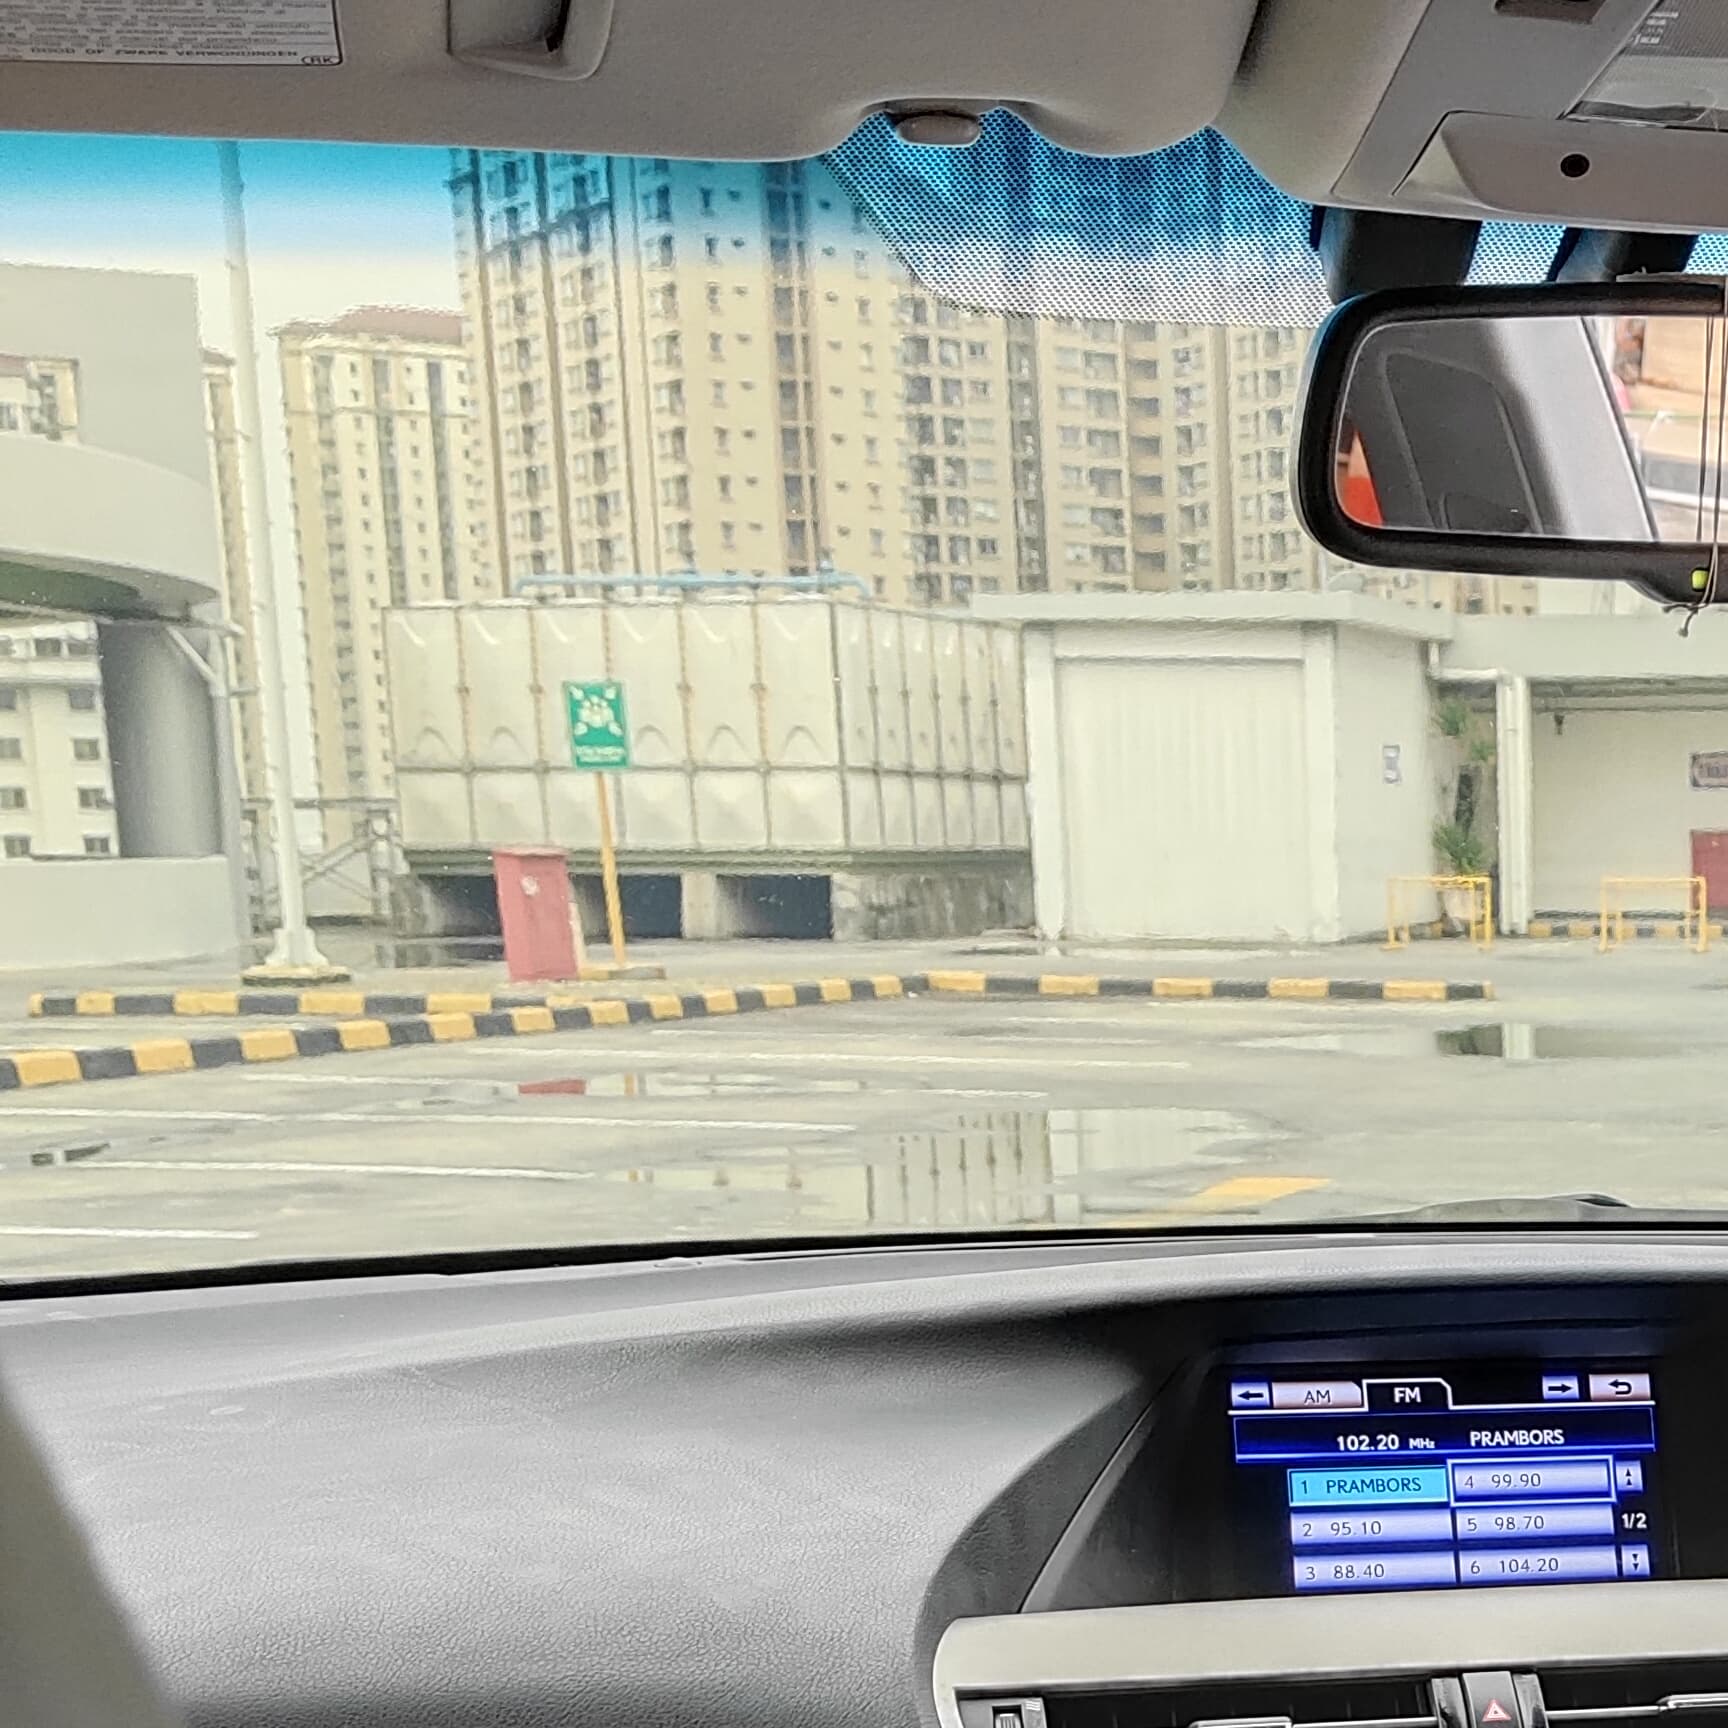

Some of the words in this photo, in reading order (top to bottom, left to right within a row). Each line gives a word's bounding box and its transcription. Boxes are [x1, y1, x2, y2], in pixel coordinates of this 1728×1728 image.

[1304, 1389, 1331, 1405] AM
[1394, 1387, 1421, 1403] FM
[1336, 1434, 1400, 1452] 102.20
[1409, 1437, 1435, 1449] MHz
[1470, 1429, 1565, 1448] PRAMBORS
[1301, 1480, 1308, 1496] 1
[1326, 1477, 1422, 1494] PRAMBORS
[1464, 1474, 1474, 1489] 4
[1491, 1473, 1542, 1488] 99.90
[1302, 1523, 1313, 1537] 2
[1330, 1520, 1382, 1536] 95.10
[1467, 1517, 1478, 1533] 5
[1494, 1515, 1545, 1531] 98.70
[1622, 1513, 1647, 1531] 1/2
[1305, 1566, 1316, 1580] 3
[1333, 1563, 1385, 1580] 88.40
[1470, 1561, 1480, 1576] 6
[1499, 1558, 1559, 1574] 104.20
